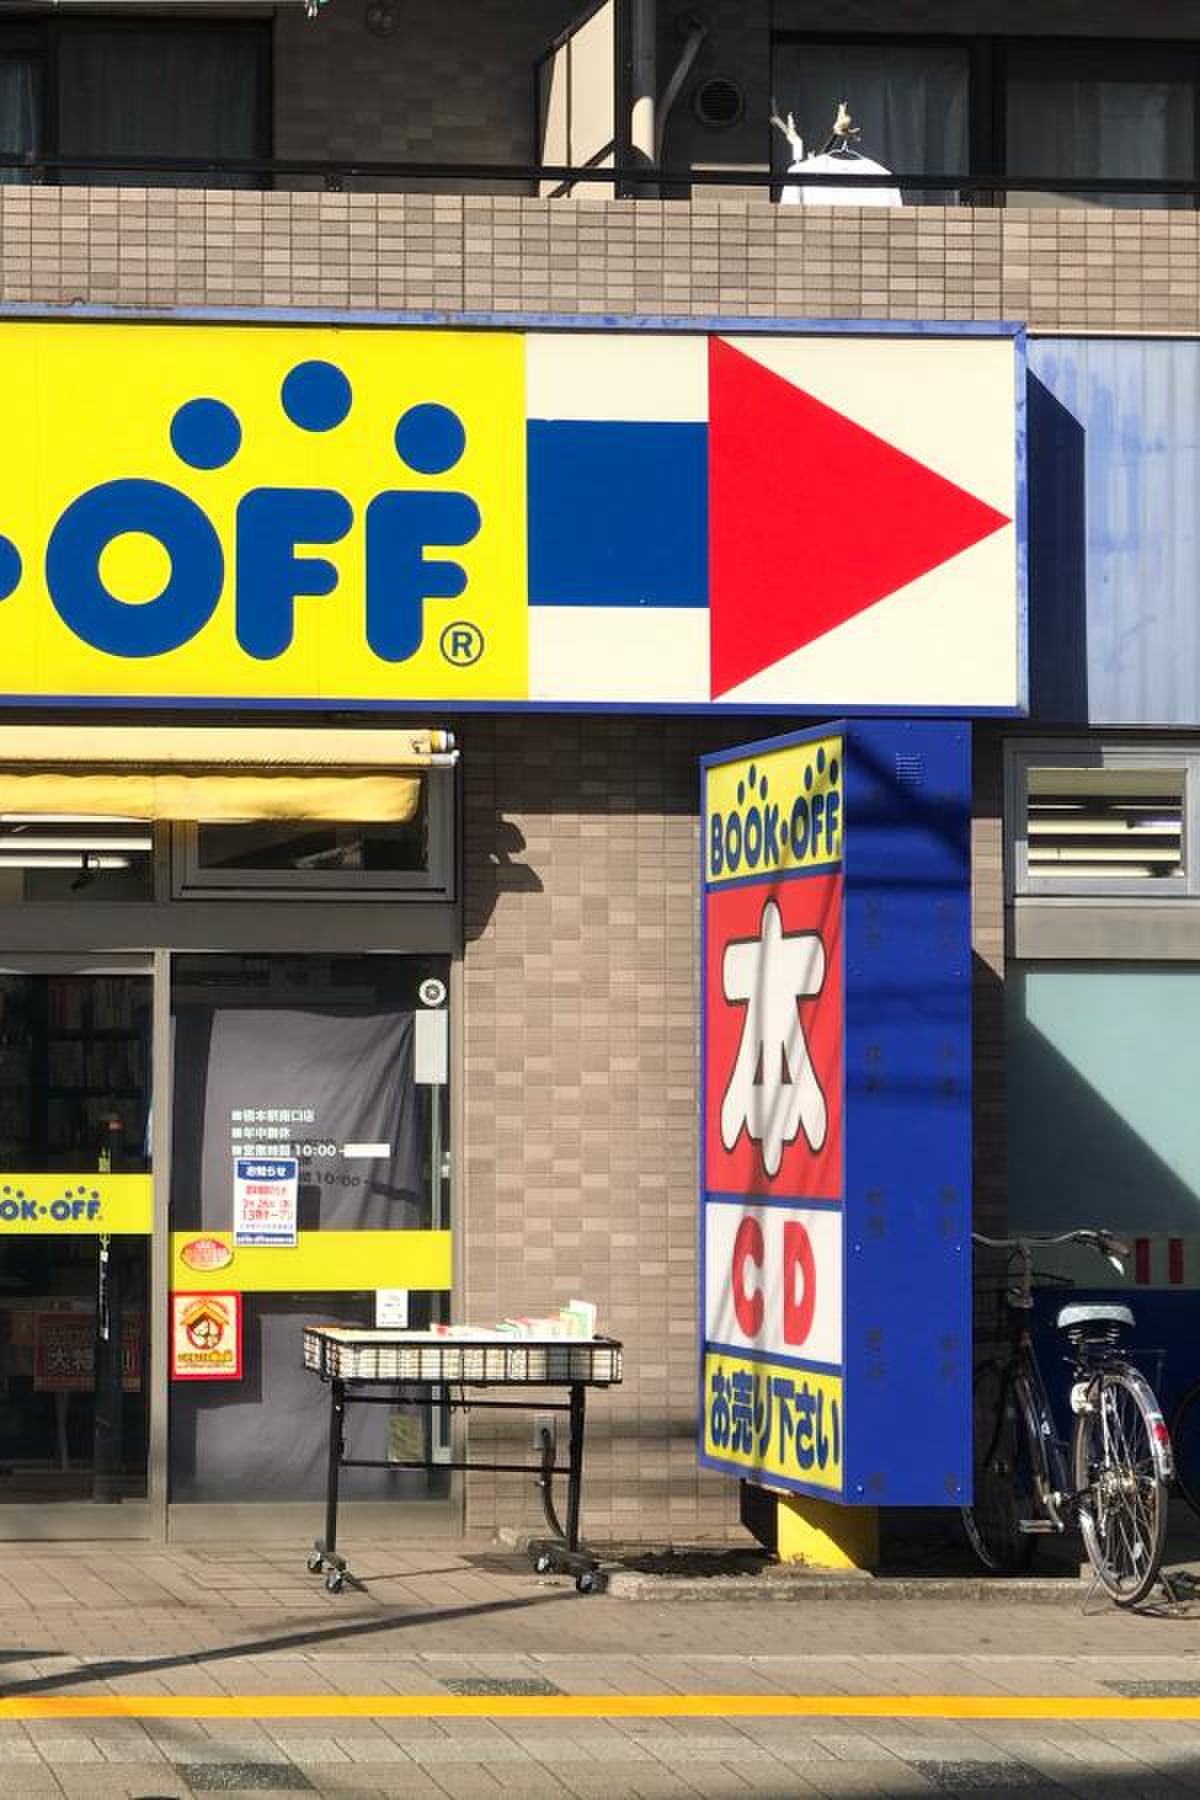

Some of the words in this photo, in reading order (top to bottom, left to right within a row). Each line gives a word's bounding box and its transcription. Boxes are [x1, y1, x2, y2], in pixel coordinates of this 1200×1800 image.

[720, 896, 829, 1180] 本
[710, 1365, 840, 1471] お売り下さい
